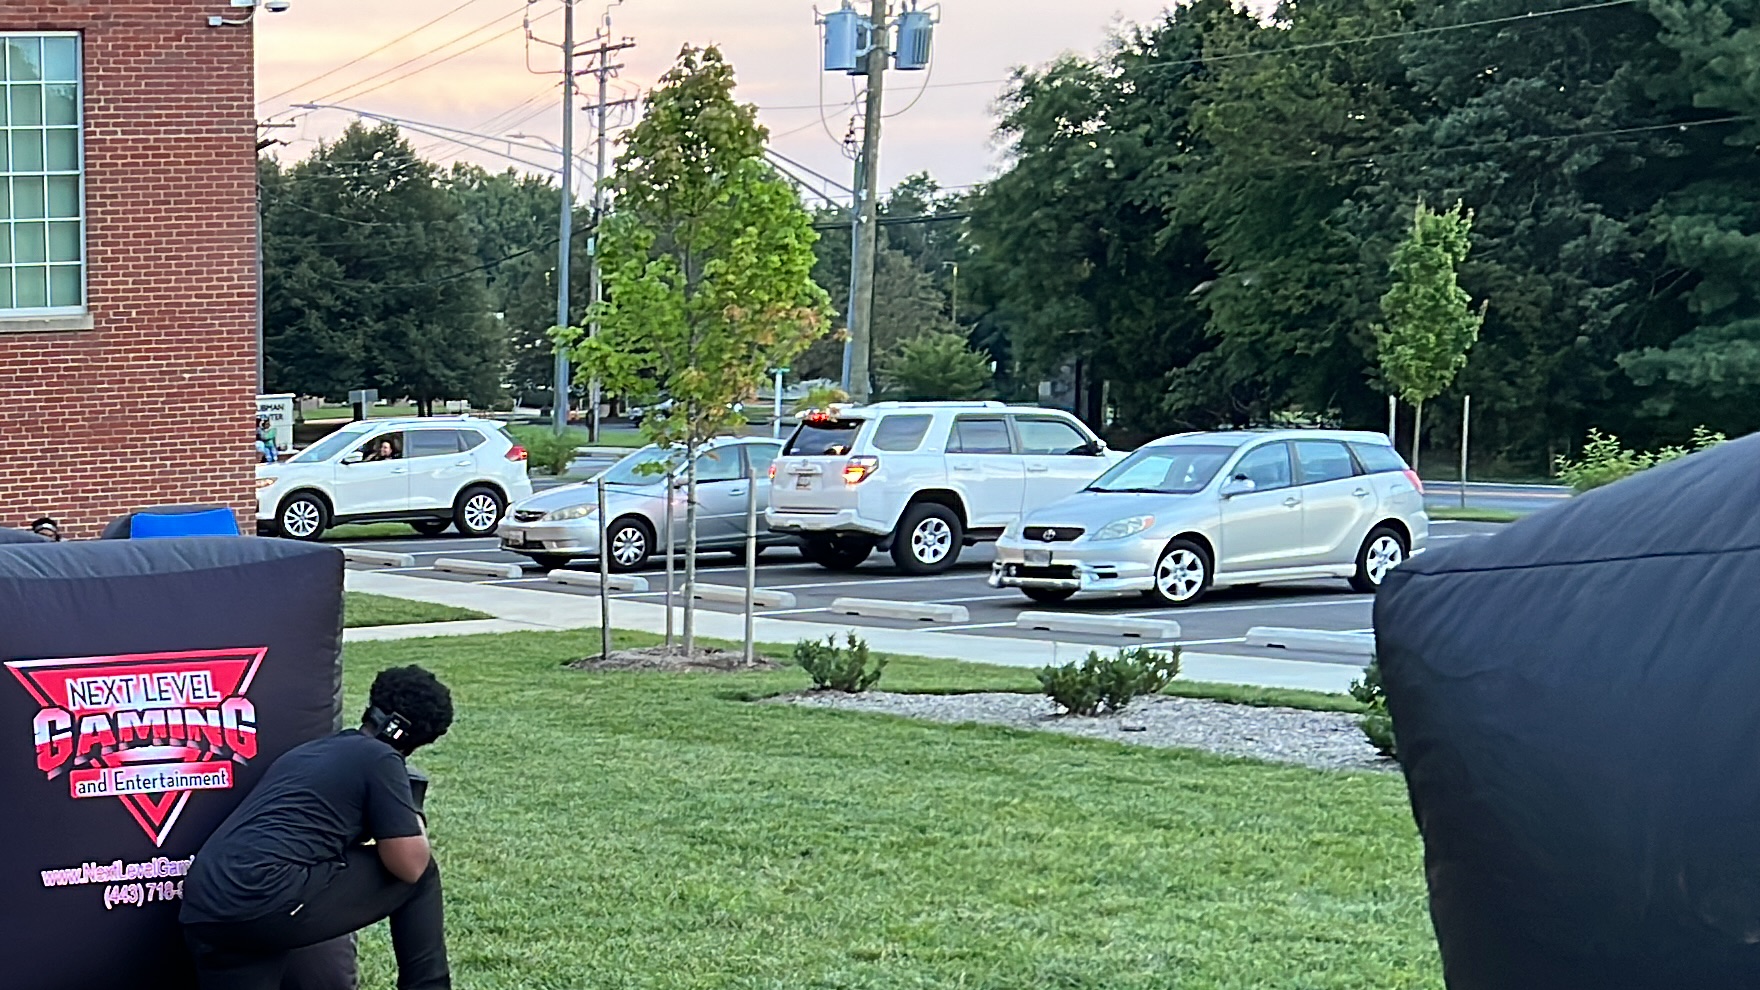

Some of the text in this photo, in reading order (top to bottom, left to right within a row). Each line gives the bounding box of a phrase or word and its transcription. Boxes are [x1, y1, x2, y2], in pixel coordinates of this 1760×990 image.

[68, 674, 219, 708] NEXT LEVEL
[33, 697, 258, 774] GAMING
[77, 770, 228, 795] and Entertainment
[41, 855, 195, 887] www.NextLevelGam
[104, 883, 144, 910] (443)
